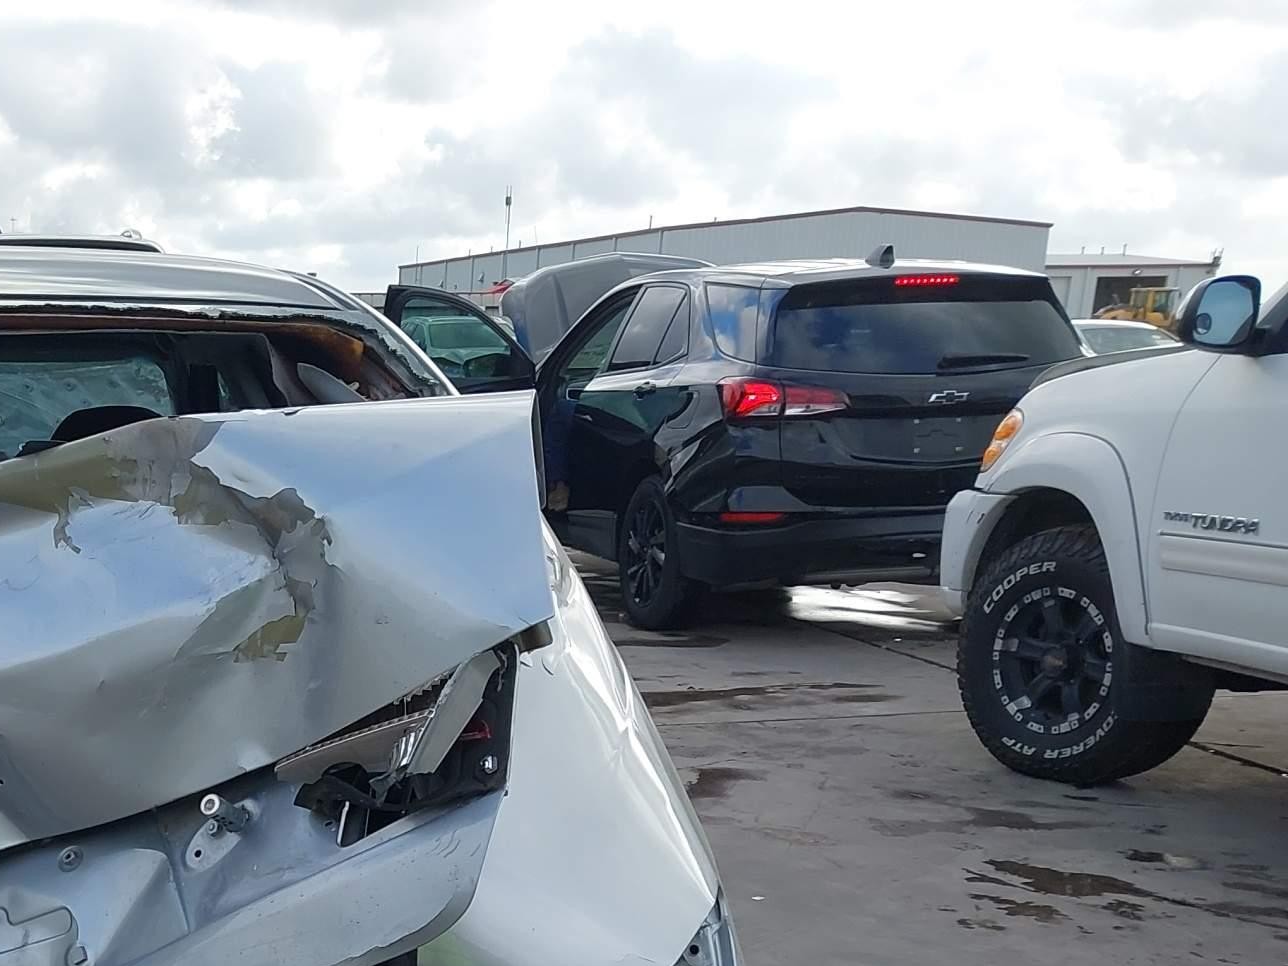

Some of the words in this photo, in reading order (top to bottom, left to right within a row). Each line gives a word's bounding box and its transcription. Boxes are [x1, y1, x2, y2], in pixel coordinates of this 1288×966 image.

[1192, 512, 1260, 535] TUNDRA
[983, 561, 1056, 614] COOPER
[1001, 736, 1037, 755] ATP
